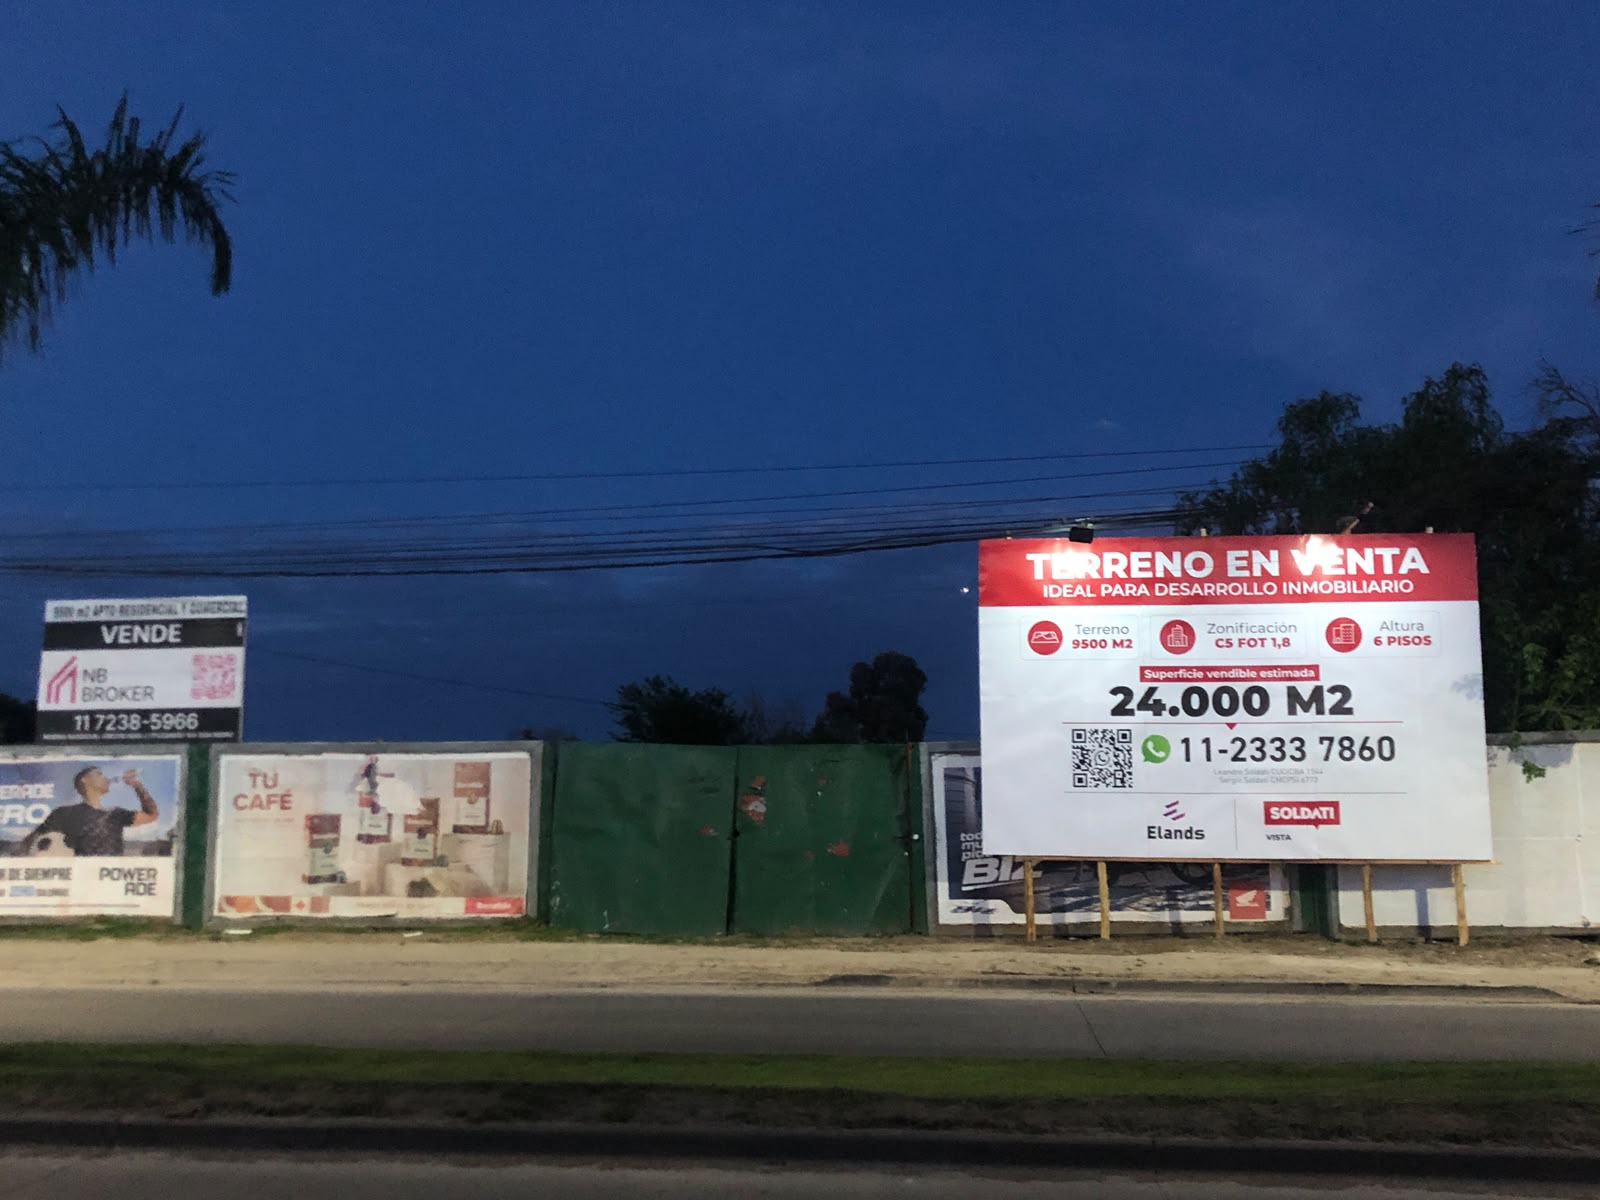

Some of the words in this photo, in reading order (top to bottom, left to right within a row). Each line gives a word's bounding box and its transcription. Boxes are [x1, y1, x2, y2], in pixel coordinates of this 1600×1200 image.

[1026, 550, 1214, 580] TERRENO
[1226, 549, 1280, 577] EN
[1290, 547, 1430, 576] VENTA
[1043, 583, 1096, 598] IDEAL
[1101, 583, 1150, 597] PARA
[1155, 581, 1277, 597] DESARROLLO
[1283, 579, 1414, 595] INMOBILIARIO
[1075, 624, 1130, 635] Terreno
[1207, 621, 1298, 635] Zonificación
[1380, 620, 1425, 632] Altura
[101, 624, 182, 644] VENDE
[1373, 636, 1383, 646] 6
[1387, 635, 1432, 646] PISOS
[1072, 639, 1108, 649] 9500
[1112, 638, 1133, 649] M2
[1215, 637, 1233, 648] C5
[1238, 637, 1267, 648] FOT
[1272, 637, 1291, 650] 1,8
[82, 668, 108, 684] NB
[1144, 668, 1203, 680] Superficie
[1206, 668, 1257, 679] vendible
[1259, 667, 1315, 678] estimada
[82, 686, 155, 702] BROKER
[1109, 685, 1271, 717] 24.000
[1286, 684, 1354, 716] M2
[74, 714, 91, 731] 11
[95, 713, 199, 731] 7238-5966
[1180, 736, 1307, 763] 11-2333
[1319, 735, 1396, 762] 7860
[233, 788, 293, 811] CAFÉ
[1270, 806, 1335, 820] SOLDATI
[1147, 825, 1205, 840] Elands
[1266, 833, 1292, 841] VISTA
[98, 867, 158, 881] POWER
[124, 882, 157, 896] ADE
